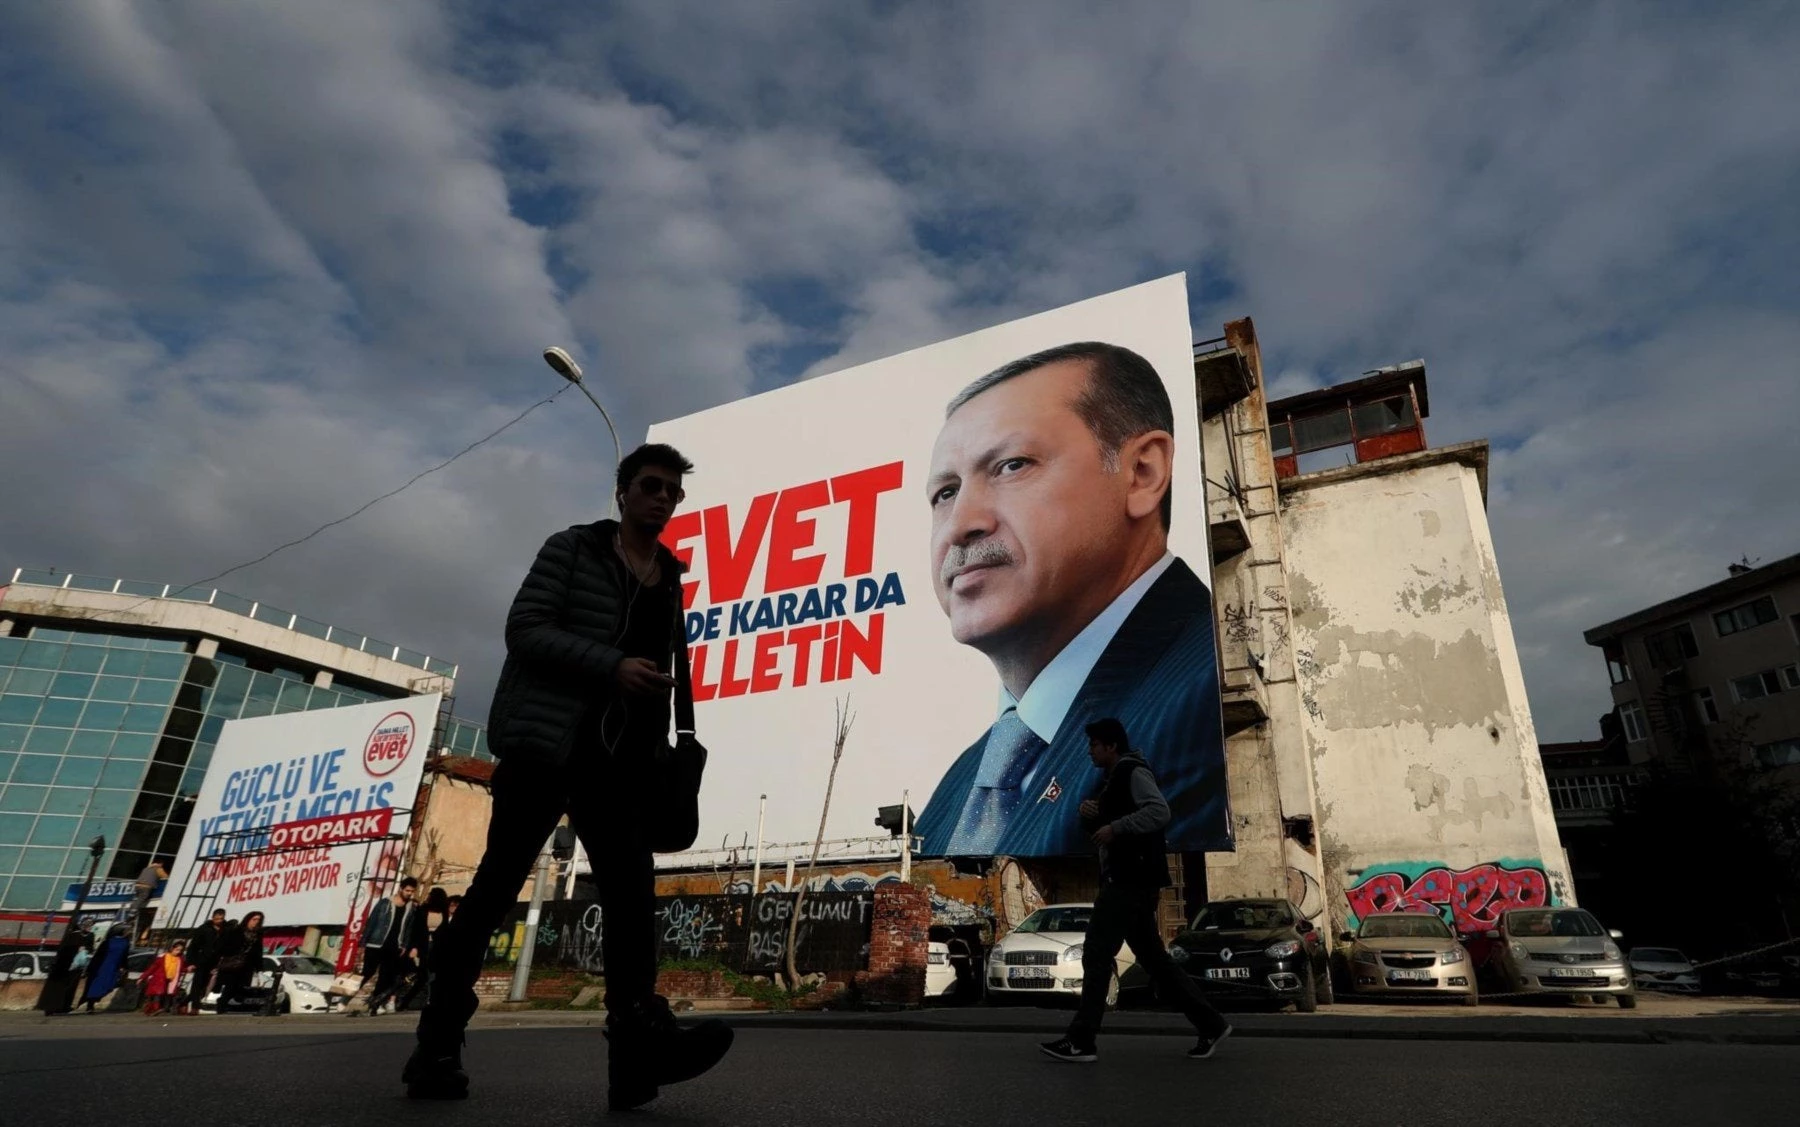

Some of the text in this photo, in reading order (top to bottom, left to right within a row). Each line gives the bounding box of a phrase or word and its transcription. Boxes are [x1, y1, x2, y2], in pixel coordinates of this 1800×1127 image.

[658, 460, 904, 610] EVET
[728, 582, 847, 636] KARAR
[854, 571, 906, 613] DA
[367, 733, 408, 762] evet
[221, 748, 346, 811] GÜÇLÜ VE
[271, 813, 385, 846] OTOPARK
[197, 845, 333, 884] KANUNLARI SADECE
[226, 862, 342, 904] MECLİS YAPIYOR
[88, 883, 103, 896] ES
[103, 882, 116, 896] ES
